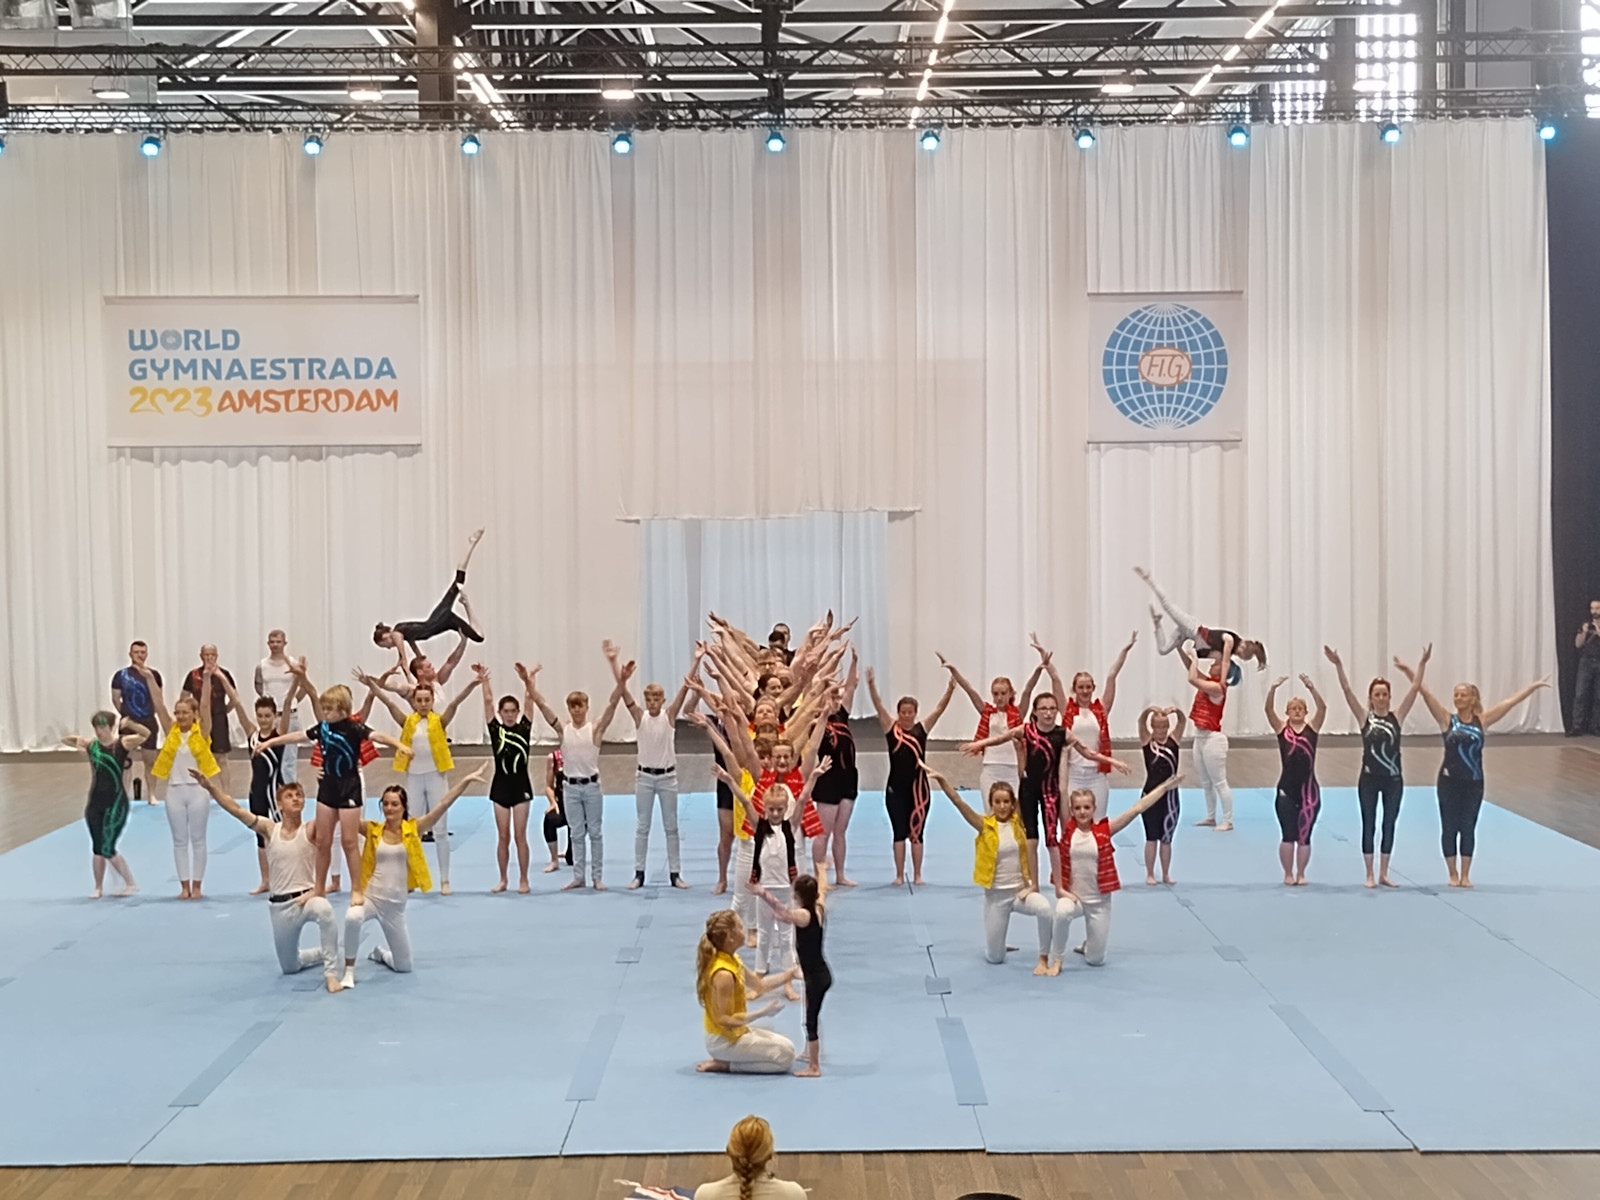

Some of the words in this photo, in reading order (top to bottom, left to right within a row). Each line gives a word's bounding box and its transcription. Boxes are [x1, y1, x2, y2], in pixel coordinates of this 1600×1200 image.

[128, 329, 241, 351] WORLD
[128, 357, 398, 381] GYMNAESTRADA
[217, 388, 399, 414] AMSTERDAM
